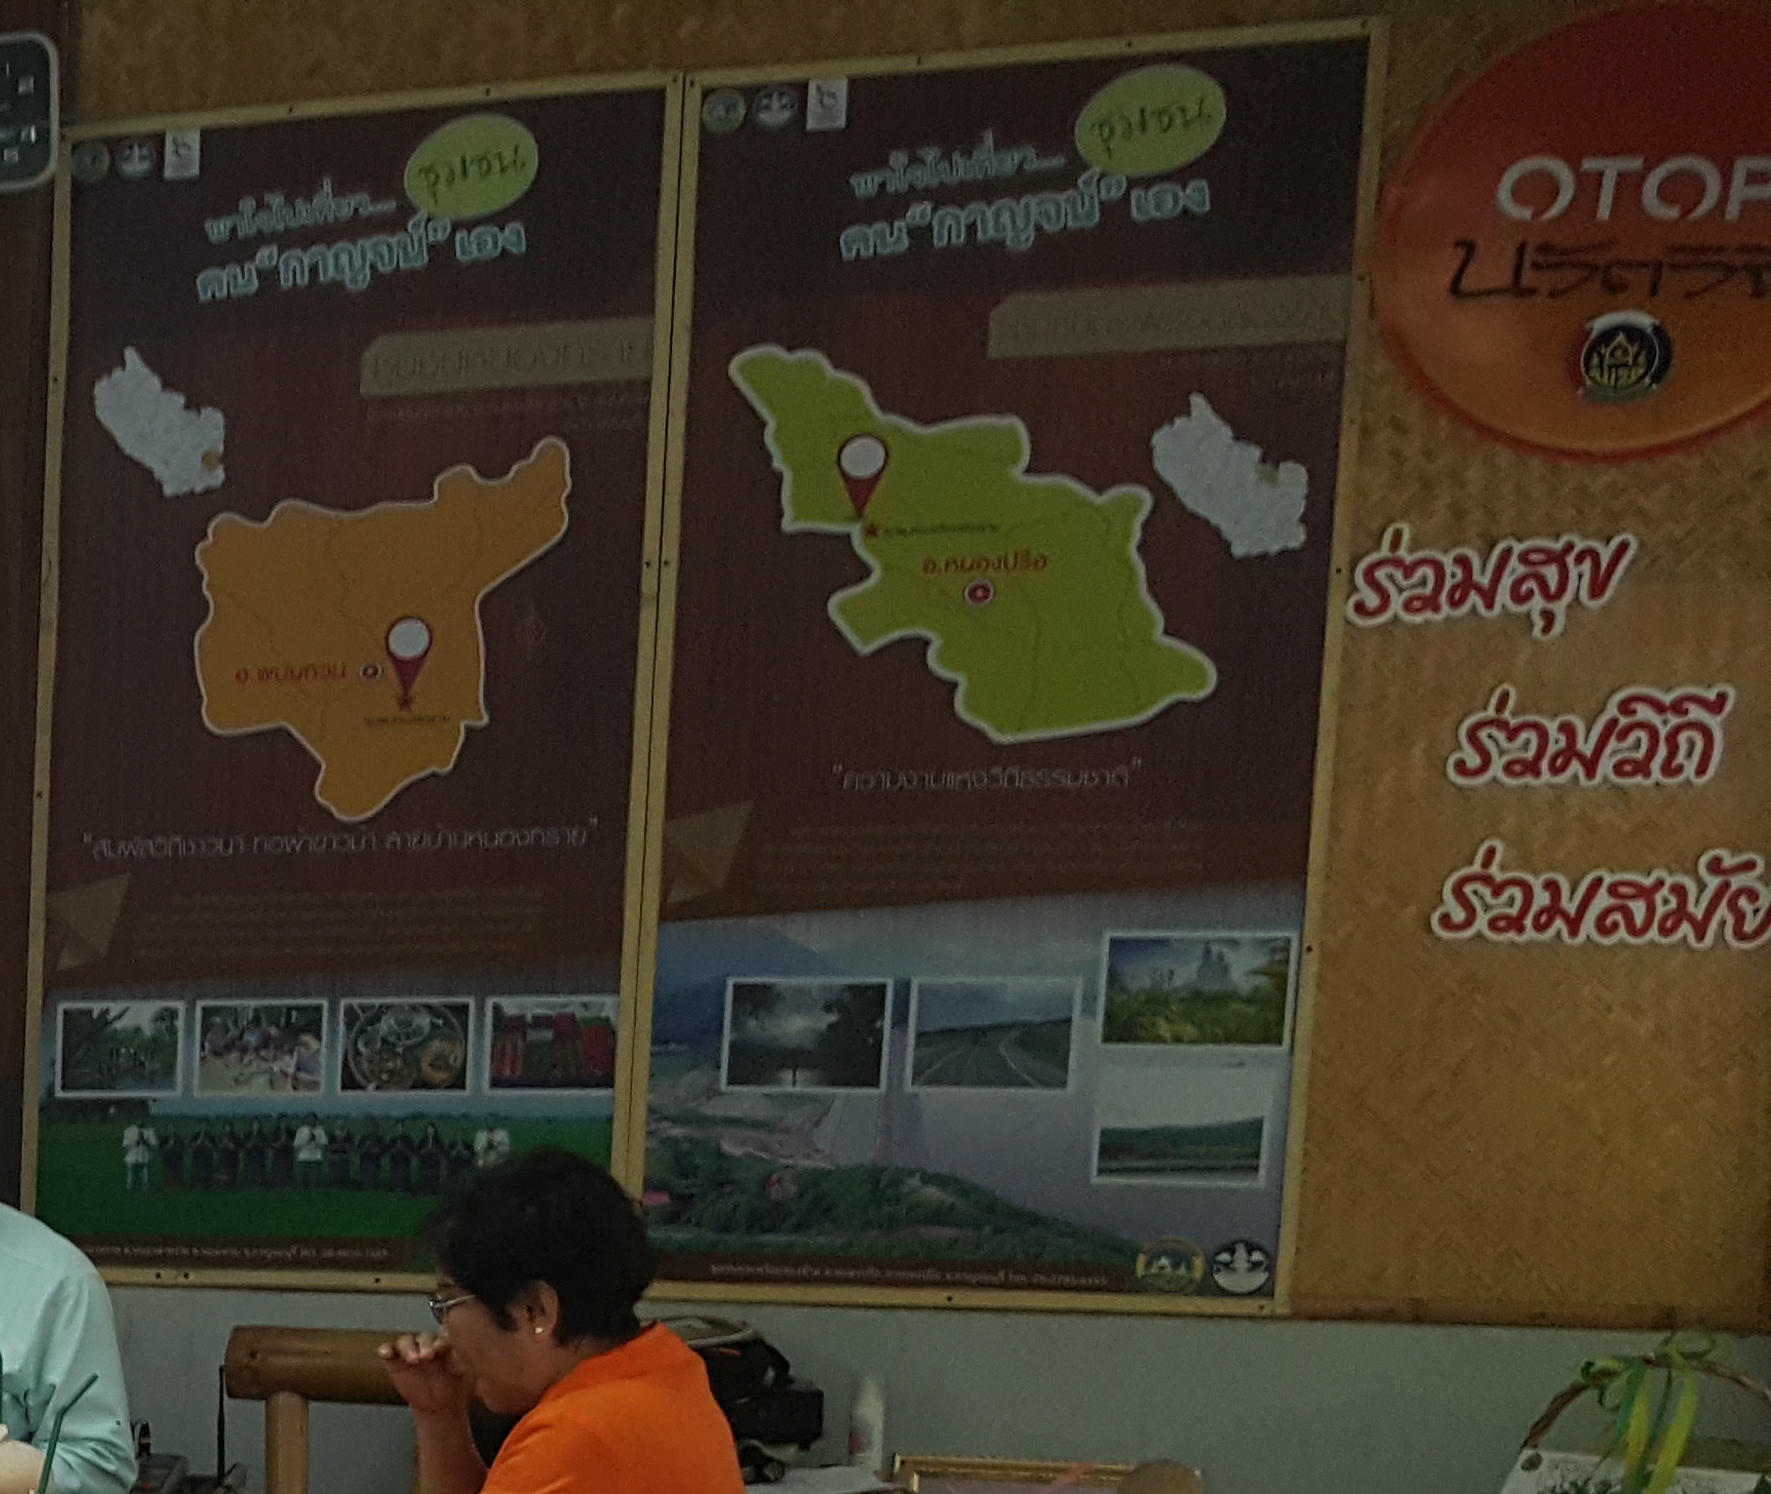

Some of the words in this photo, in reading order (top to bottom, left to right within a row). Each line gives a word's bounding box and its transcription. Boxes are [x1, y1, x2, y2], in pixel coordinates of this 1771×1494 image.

[1348, 523, 1636, 638] ร่วมสุข
[1447, 683, 1735, 786] ร่วมวิถี
